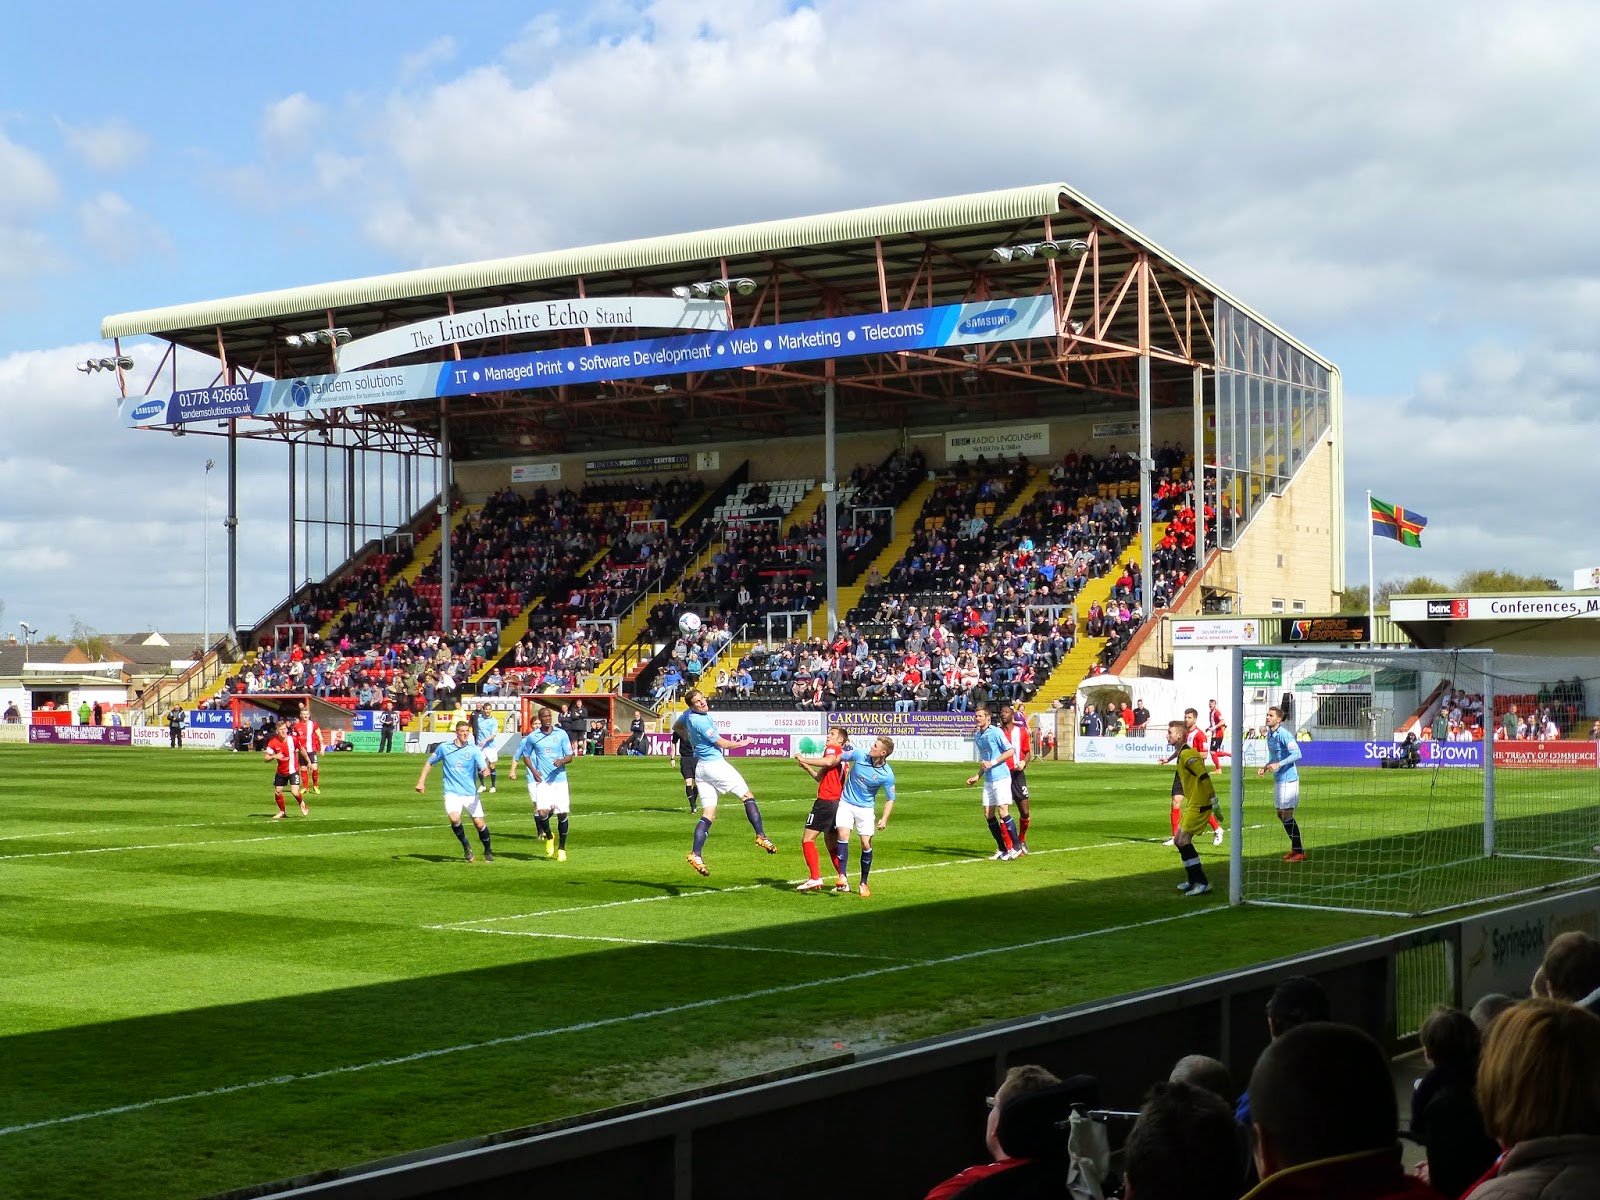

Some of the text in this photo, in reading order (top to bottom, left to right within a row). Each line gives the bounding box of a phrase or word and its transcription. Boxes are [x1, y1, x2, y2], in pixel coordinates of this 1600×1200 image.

[410, 302, 633, 348] The Lincolnshire Echo Stand
[965, 315, 1011, 328] SAMSUNG
[454, 322, 924, 384] IT Managed Print Software Development Web Marketing Telecoms
[311, 373, 404, 395] tandem solutions
[179, 386, 249, 407] 01778 426661
[385, 389, 407, 397] education
[135, 405, 162, 415] SAMSUNG
[181, 403, 252, 419] tandemsolutions.co.uk
[952, 432, 1043, 447] BBC RADIO LINCOLNSHIRE
[654, 456, 675, 464] CENTRE
[1428, 603, 1451, 614] banc
[1491, 600, 1582, 614] Conferences,
[1312, 619, 1348, 630] SIGNS
[1243, 670, 1279, 680] First Aid
[196, 712, 206, 723] All
[208, 712, 222, 723] Your
[807, 719, 819, 727] 510
[828, 713, 911, 724] CARTWRIGHT
[932, 715, 976, 723] IMPROVEMEN
[133, 728, 159, 738] Listers
[187, 730, 216, 740] Lincoln
[847, 727, 868, 735] 681188
[893, 727, 915, 735] 194870
[759, 736, 772, 744] and
[772, 736, 784, 746] get
[923, 739, 960, 750] HOTEL
[746, 747, 789, 757] paid globally.
[1125, 743, 1163, 752] Gladwin
[1430, 742, 1478, 760] Brown
[1504, 751, 1536, 759] TREATY
[1549, 752, 1596, 760] COMMERCE
[1492, 918, 1545, 965] Springbok
